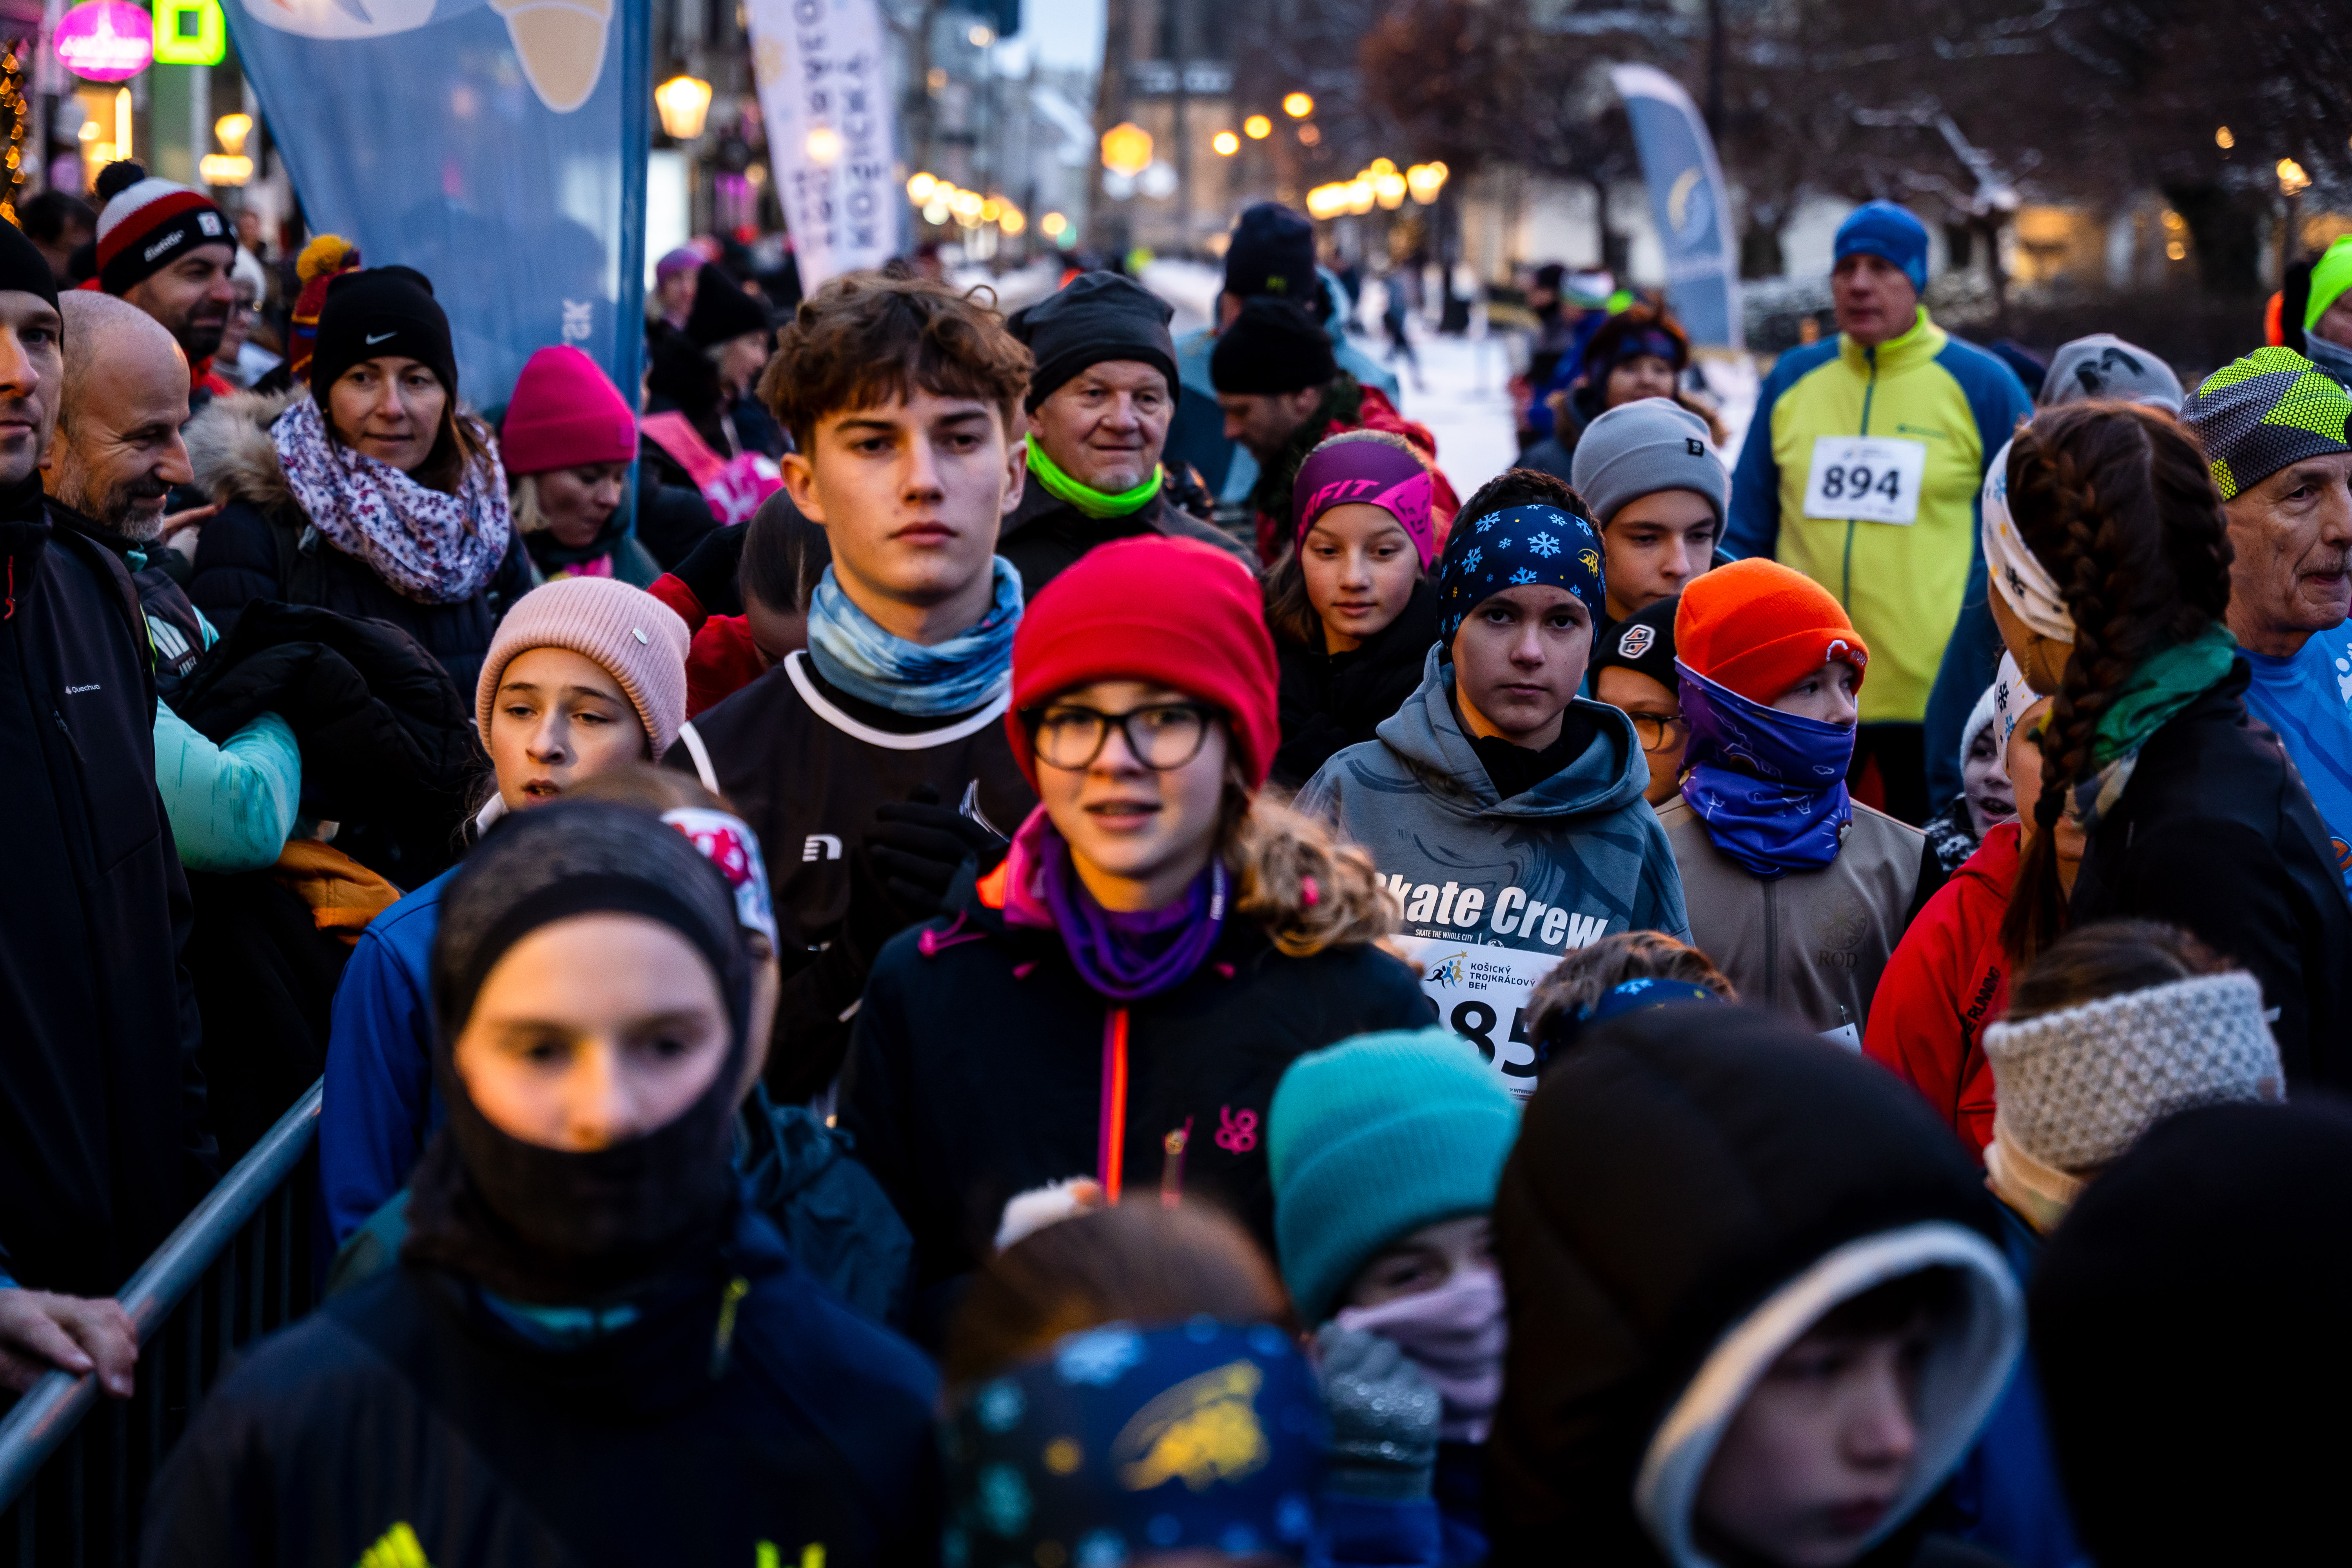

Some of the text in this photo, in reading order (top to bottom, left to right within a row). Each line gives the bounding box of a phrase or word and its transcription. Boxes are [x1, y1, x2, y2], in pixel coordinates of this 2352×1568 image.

[1822, 465, 1900, 503] 894
[72, 684, 100, 693] Quechua
[1490, 887, 1608, 950] Crew
[1415, 929, 1431, 937] SKATE
[1443, 931, 1461, 940] WHOLE
[1471, 962, 1511, 975] KOŠICKÝ
[1468, 981, 1487, 990] BEH
[1470, 972, 1536, 987] TROJKRÁĽOVÝ
[1967, 965, 2001, 1022] RUNNING
[1424, 995, 1539, 1078] 85
